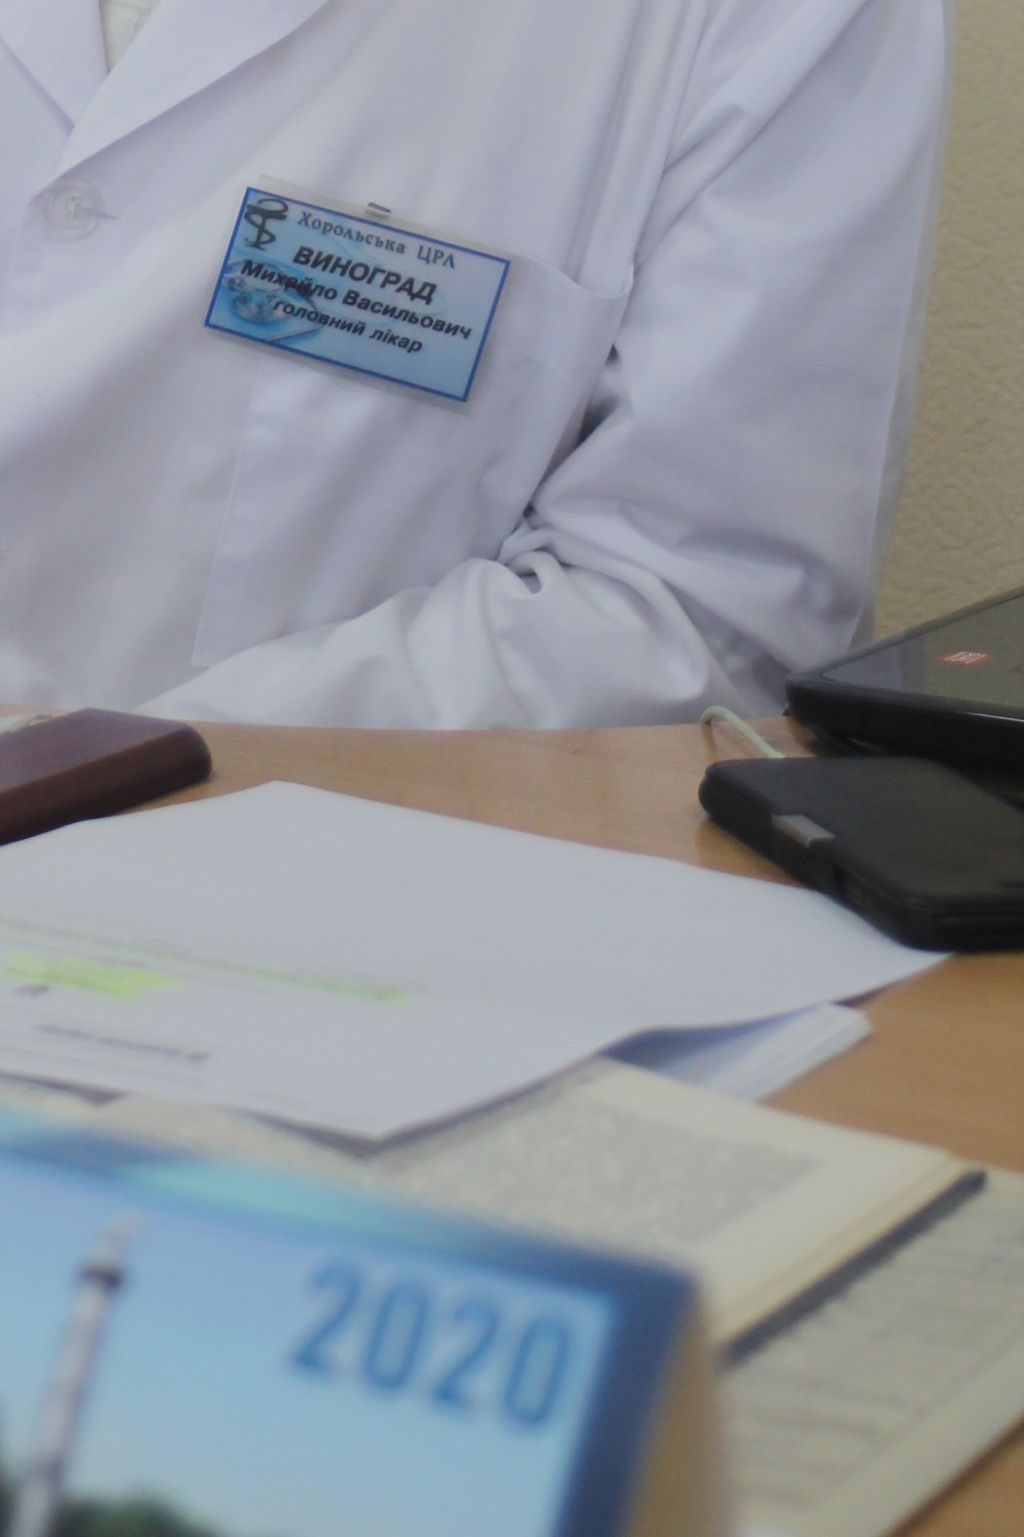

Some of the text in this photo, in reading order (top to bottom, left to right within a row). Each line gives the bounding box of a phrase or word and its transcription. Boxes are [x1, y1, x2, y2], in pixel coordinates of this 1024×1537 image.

[296, 210, 456, 270] Хорольська ЦРЛ
[240, 258, 473, 340] Михайло Васильович
[292, 245, 438, 305] ВИНОГРАД
[273, 298, 424, 355] головний лікар
[291, 1259, 573, 1429] 2020
